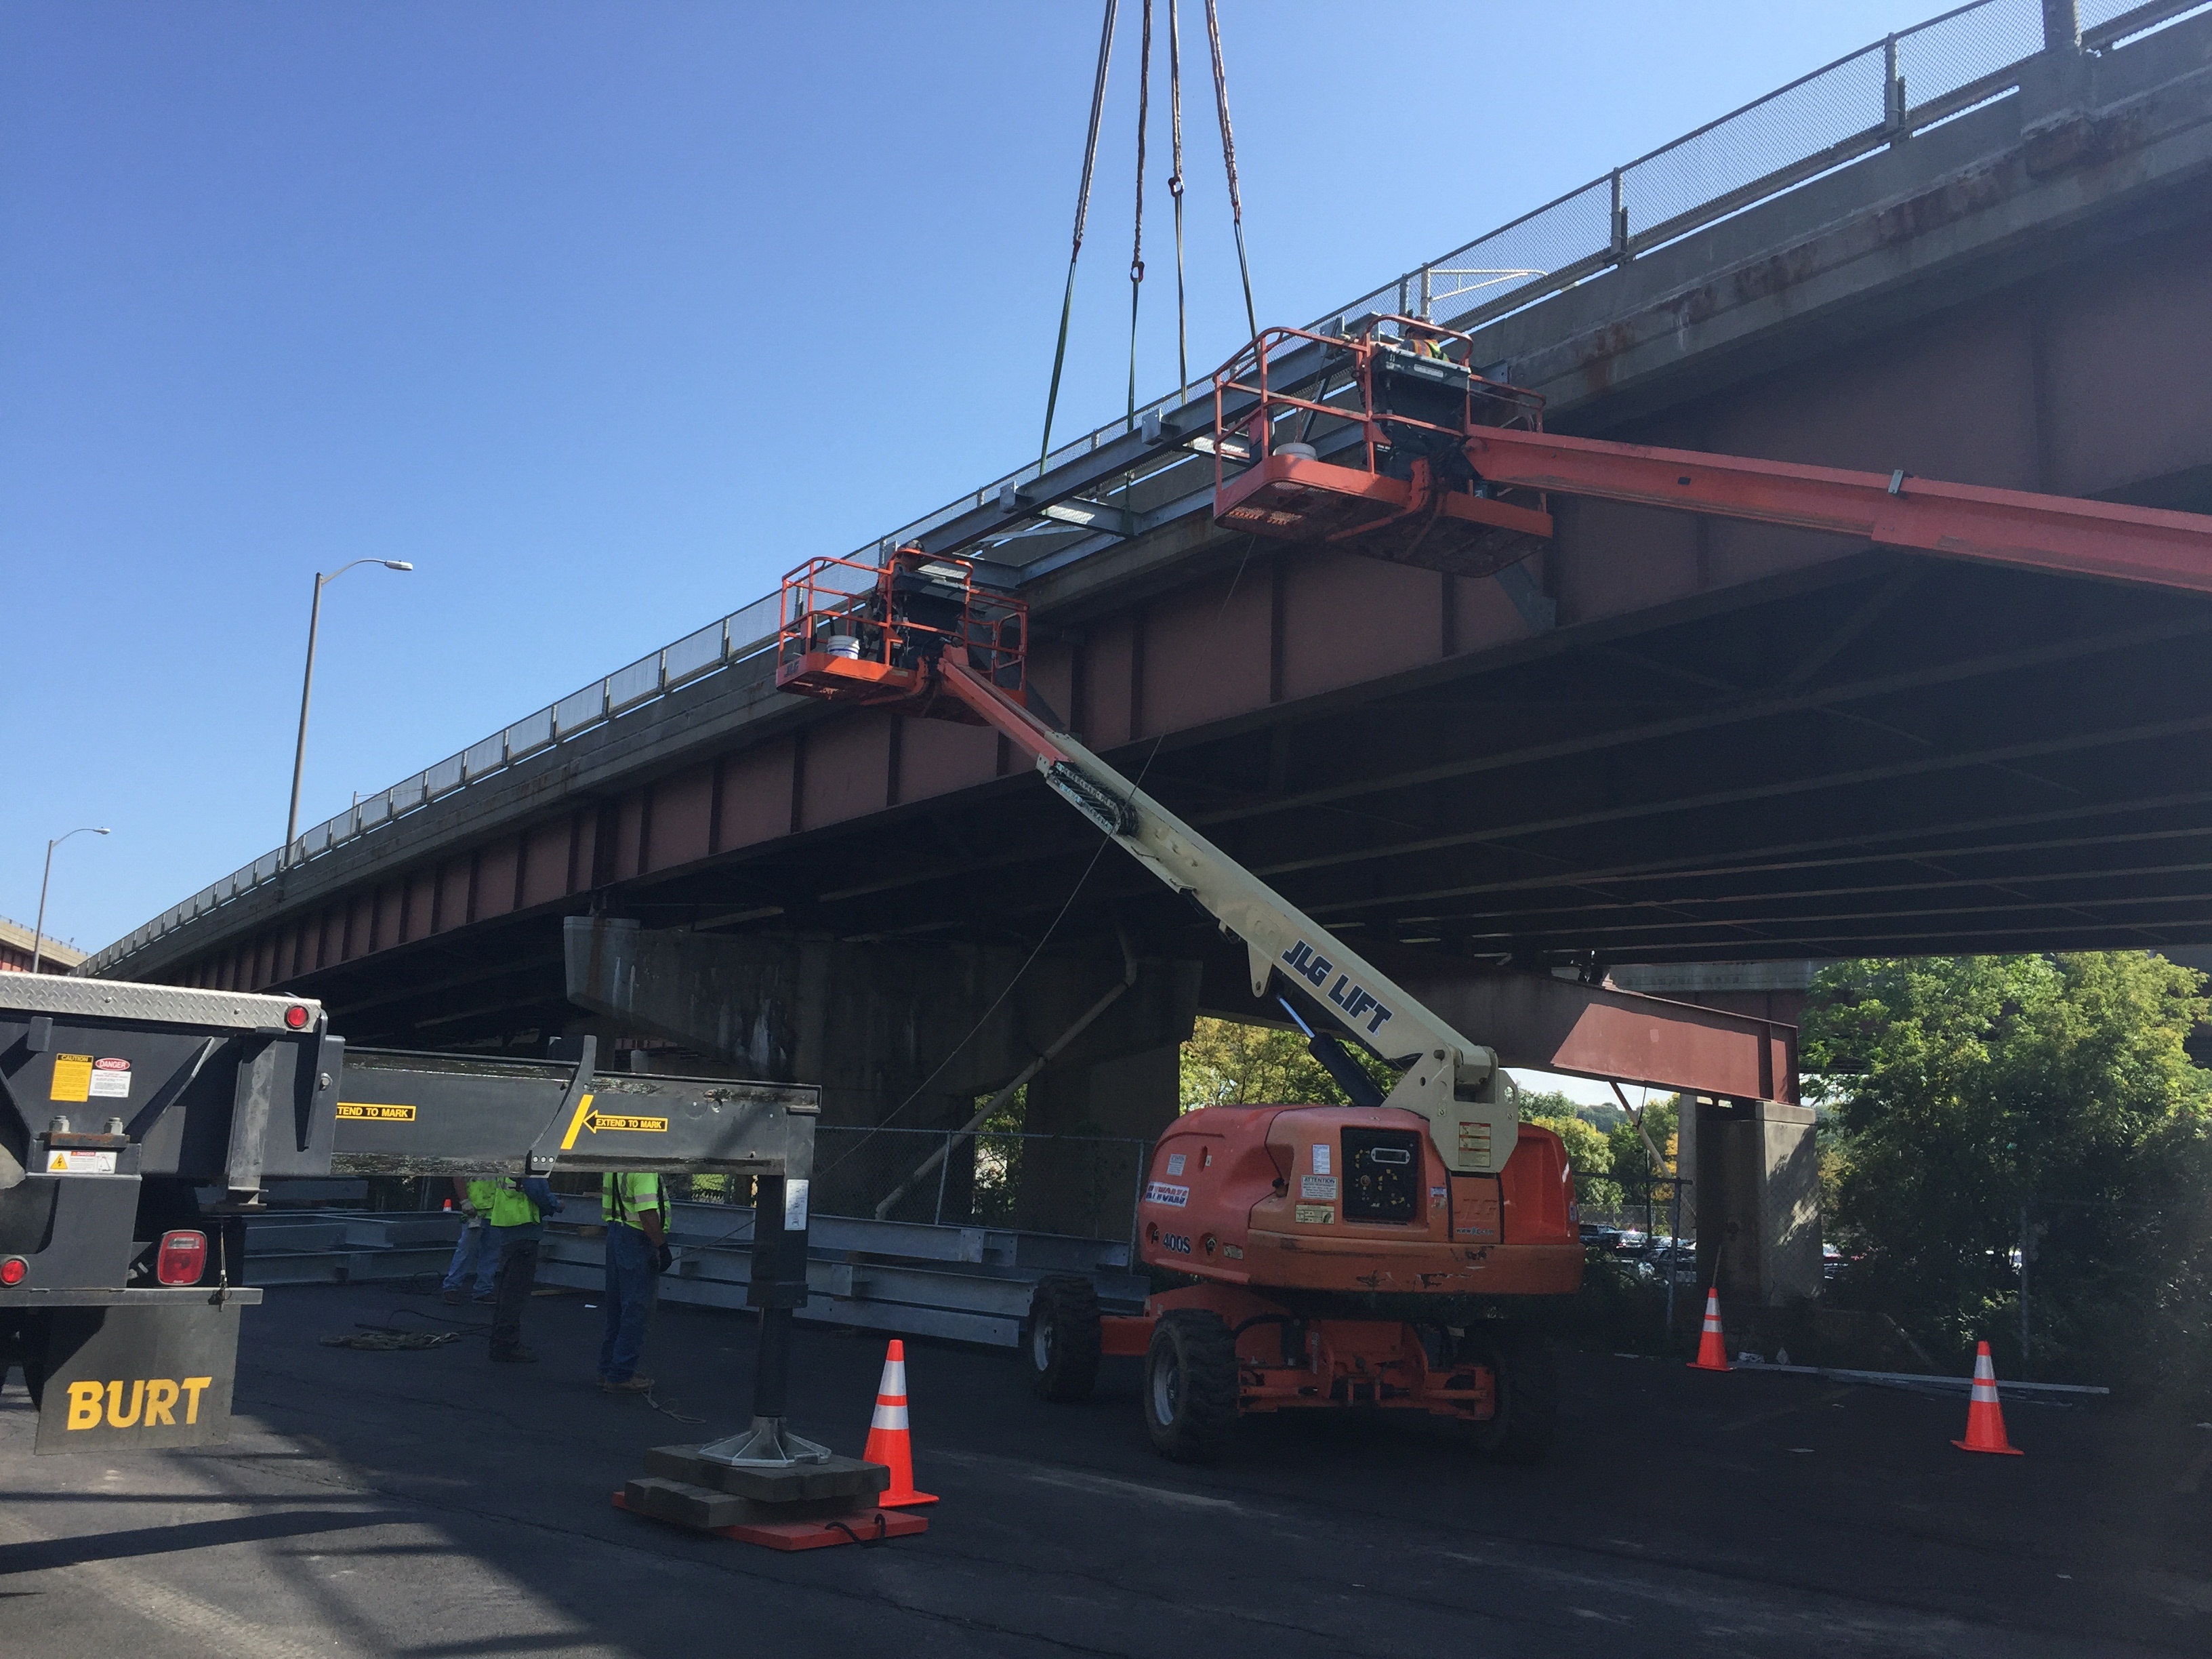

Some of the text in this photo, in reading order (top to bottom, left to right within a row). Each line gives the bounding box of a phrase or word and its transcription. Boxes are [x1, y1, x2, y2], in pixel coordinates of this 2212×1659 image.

[1280, 939, 1394, 1034] JLG LIFT
[99, 1061, 126, 1069] DANGER
[337, 1106, 408, 1118] TEND TO MARK
[596, 1118, 626, 1127] EXTEND
[640, 1120, 661, 1128] MARK
[1163, 1233, 1191, 1254] 400S
[66, 1376, 212, 1431] BURT
